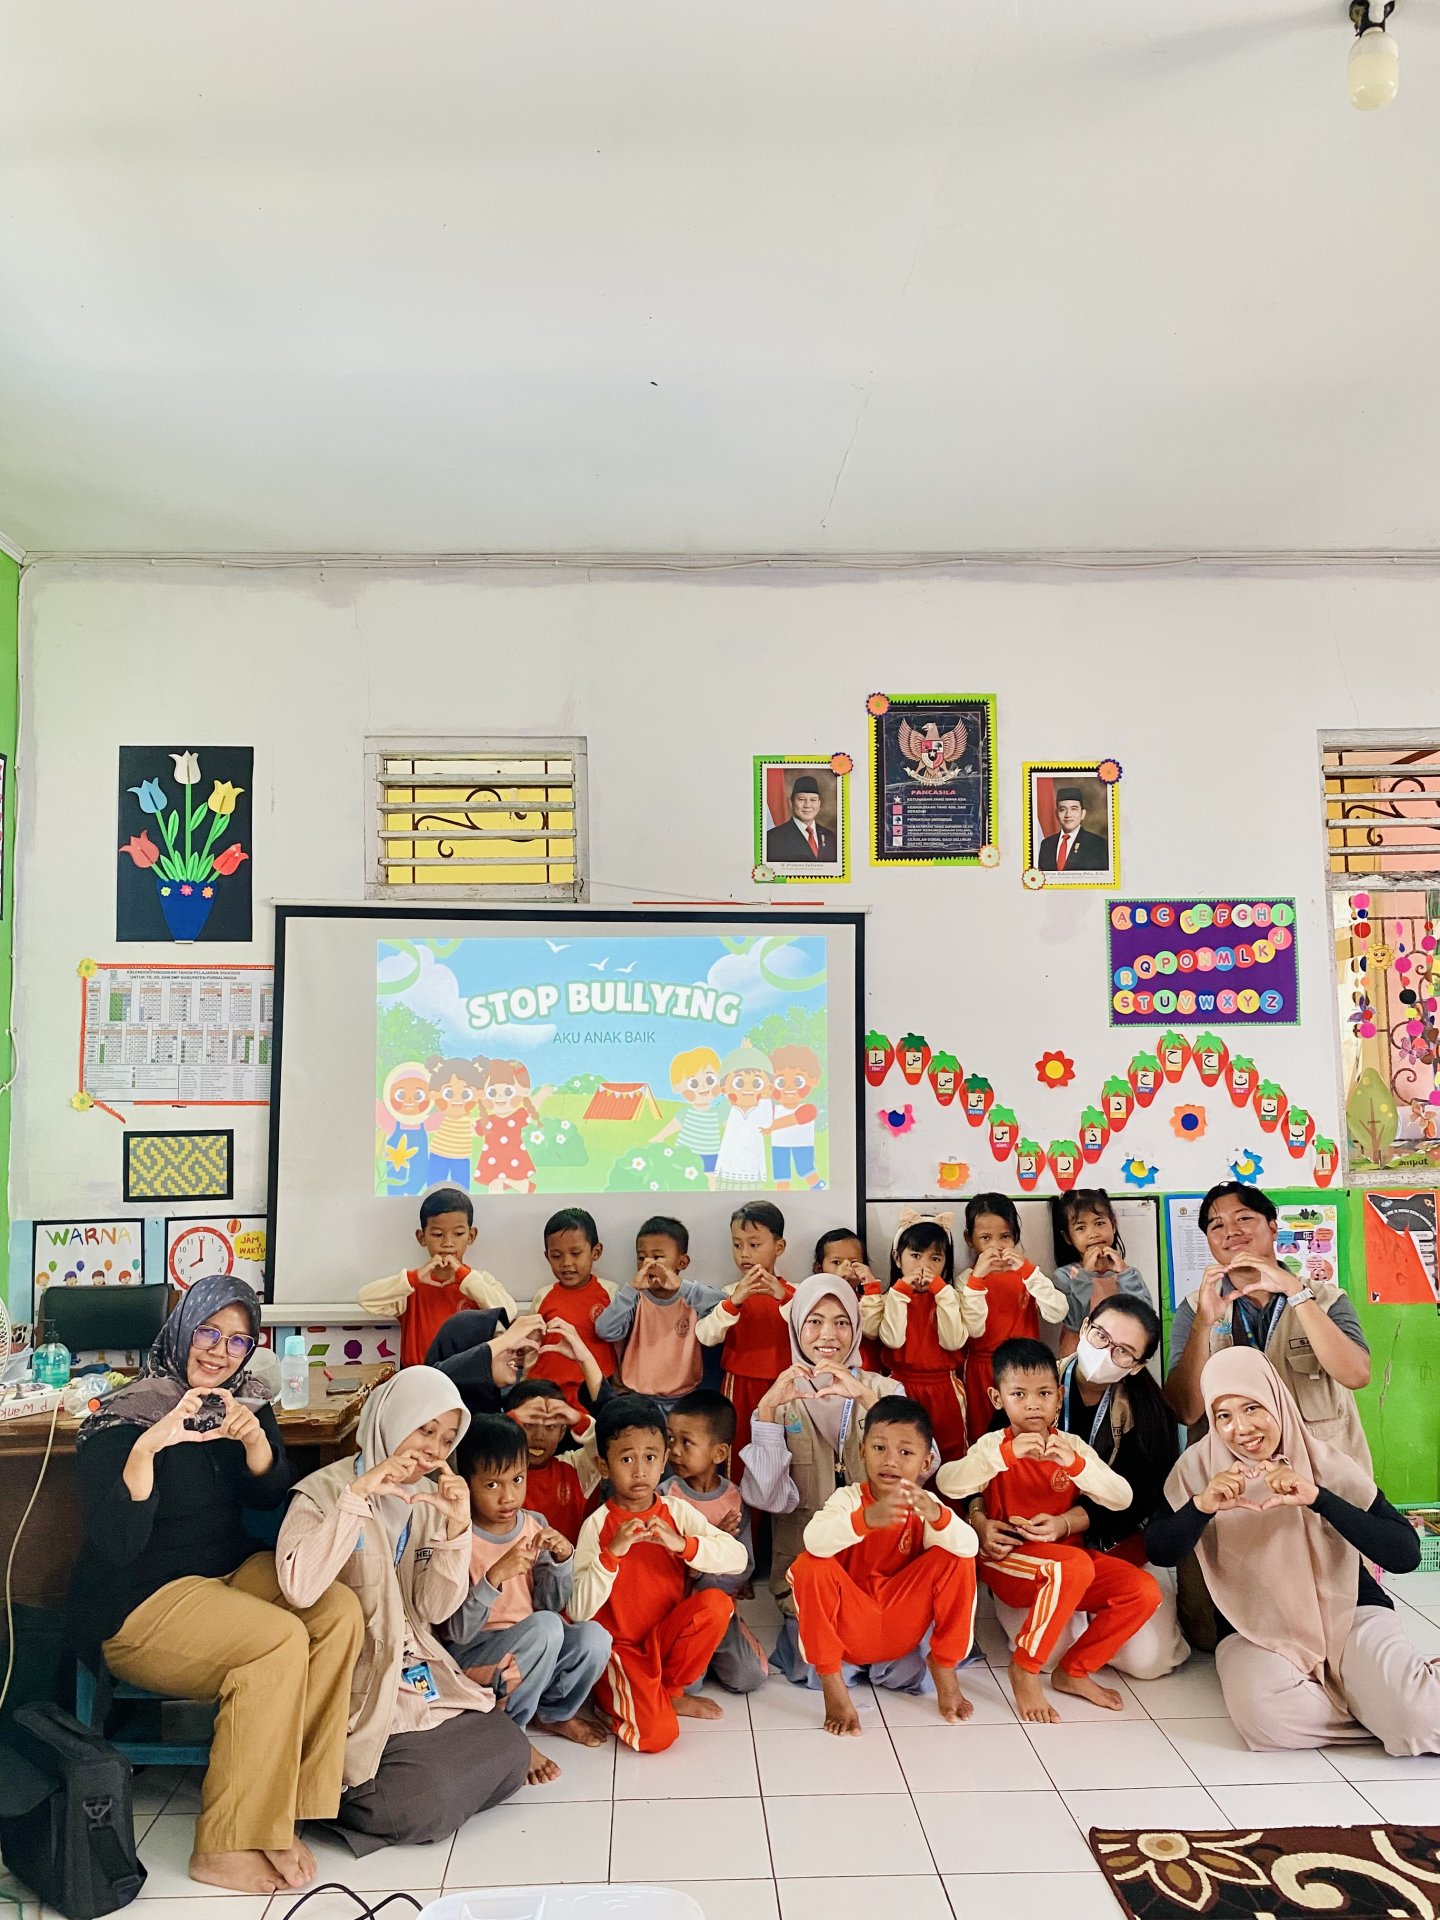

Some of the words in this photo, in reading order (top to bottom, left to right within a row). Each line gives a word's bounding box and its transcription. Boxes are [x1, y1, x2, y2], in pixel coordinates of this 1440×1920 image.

[467, 984, 559, 1028] STOP
[567, 981, 741, 1026] BULLYING
[553, 1032, 580, 1044] AKU
[584, 1032, 622, 1044] ANAK
[625, 1031, 656, 1043] BAIK
[1167, 1050, 1181, 1064] ح
[1204, 1054, 1218, 1068] ج
[939, 1078, 953, 1087] ص
[1140, 1072, 1152, 1086] خ
[1234, 1074, 1248, 1086] ث
[970, 1095, 983, 1107] ش
[1114, 1101, 1122, 1111] د
[1263, 1103, 1276, 1113] ت
[995, 1131, 1008, 1141] س
[1089, 1130, 1097, 1142] ذ
[1291, 1130, 1305, 1140] ب
[1022, 1158, 1033, 1171] ز
[1060, 1159, 1071, 1171] ر
[45, 1227, 132, 1246] WARNA
